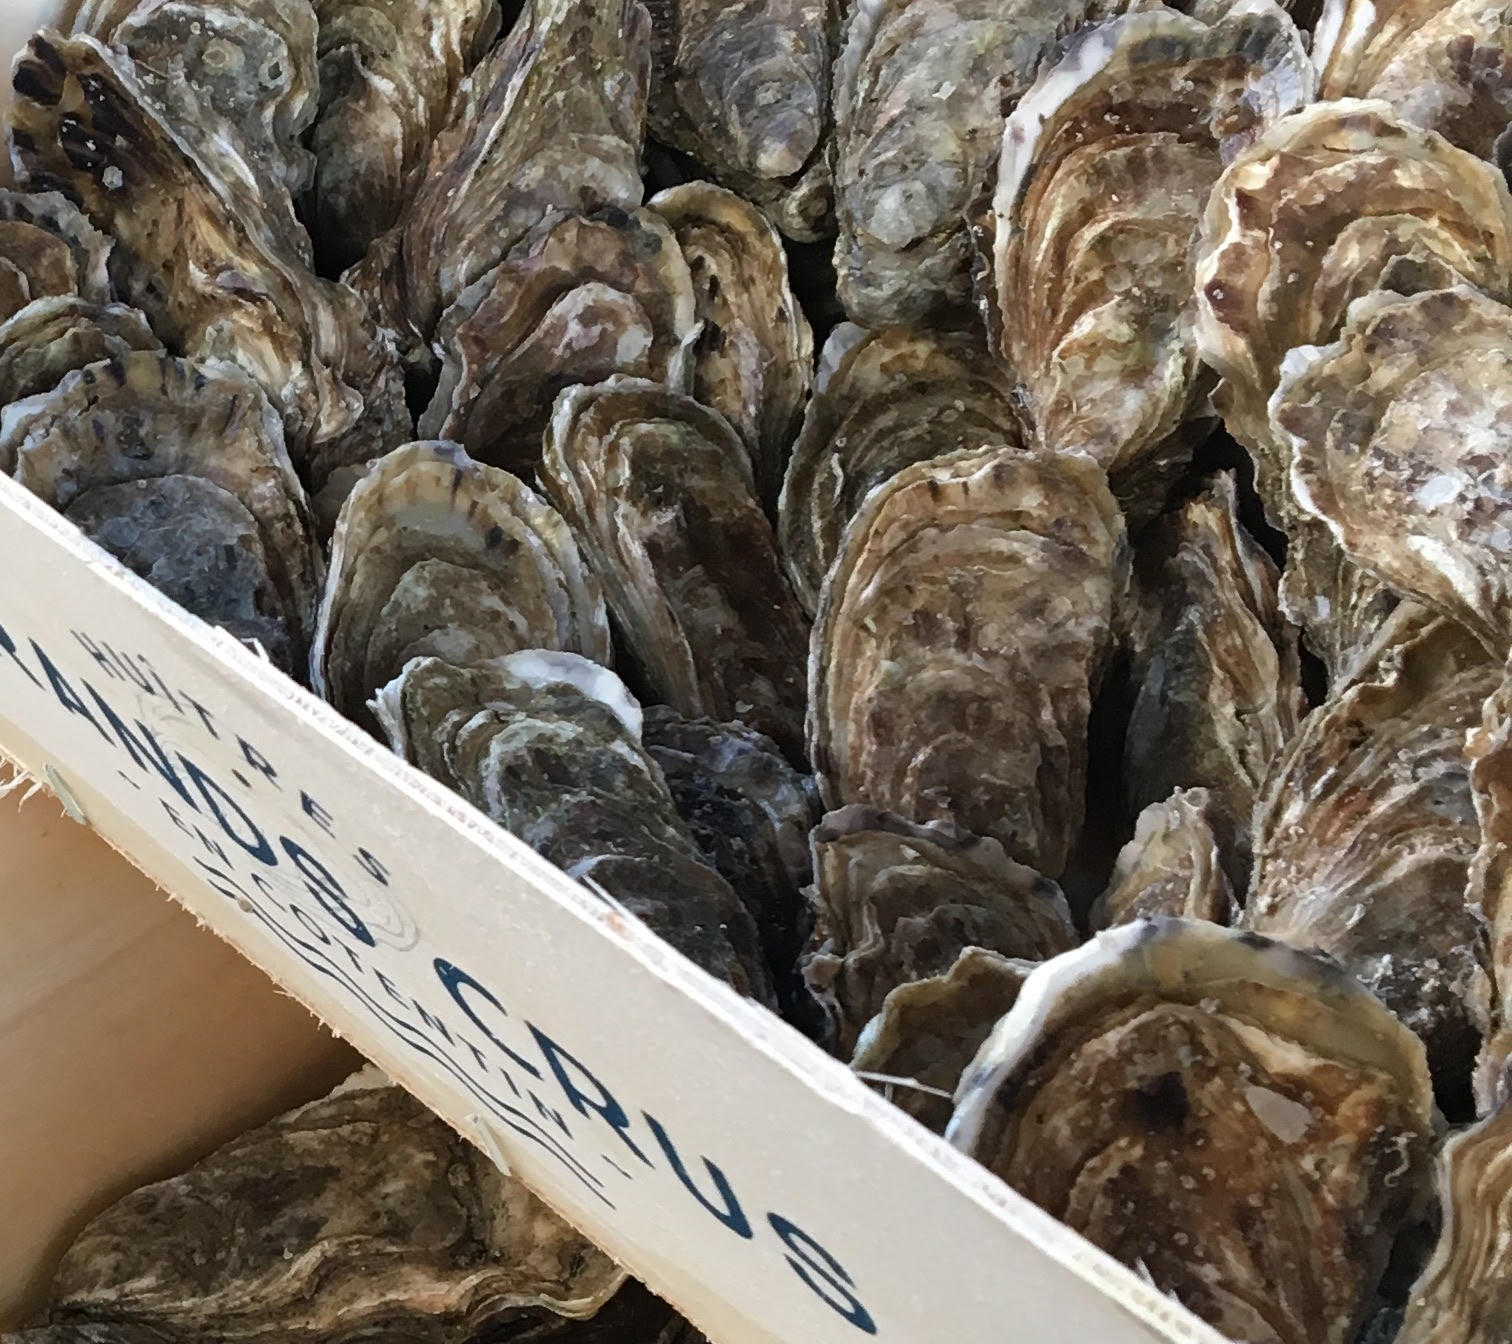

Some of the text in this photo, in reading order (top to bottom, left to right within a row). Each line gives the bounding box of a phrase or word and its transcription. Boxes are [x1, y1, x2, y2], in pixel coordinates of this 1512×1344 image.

[160, 797, 574, 1141] EN COTENTIN
[433, 957, 878, 1336] CRUS
